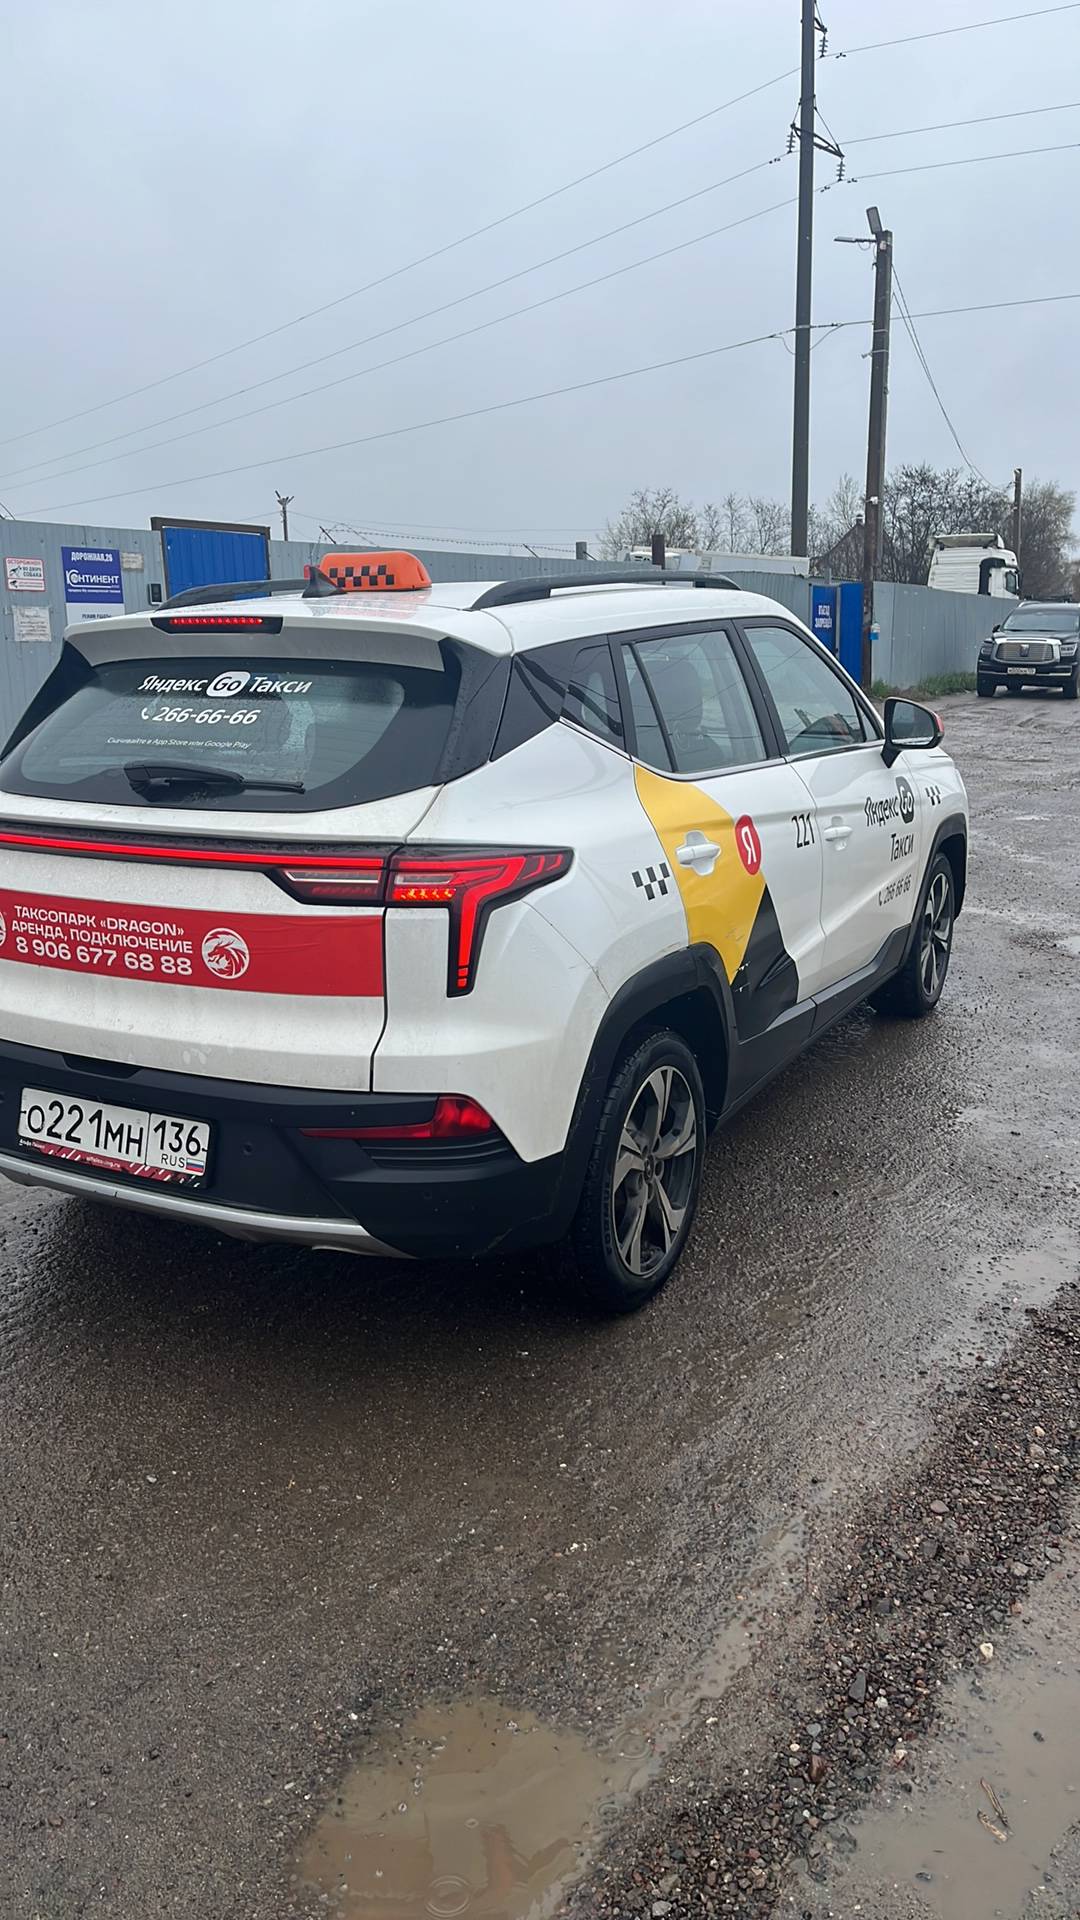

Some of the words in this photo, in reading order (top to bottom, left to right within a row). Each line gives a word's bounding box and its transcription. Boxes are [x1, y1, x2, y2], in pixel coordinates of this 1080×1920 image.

[138, 675, 208, 692] Яндекс
[213, 676, 242, 691] Go
[250, 676, 313, 693] Такси
[152, 707, 261, 724] 266-66-66
[152, 738, 168, 747] App
[168, 738, 188, 747] Store
[204, 740, 233, 749] Google
[232, 741, 252, 750] Play
[864, 796, 899, 827] Яндекс
[900, 785, 914, 814] Go
[741, 826, 757, 864] Я
[791, 811, 815, 848] 221
[890, 832, 914, 862] Такси
[14, 905, 96, 927] ТАКСОПАРК
[100, 917, 184, 936] «DRAGON»
[12, 920, 67, 942] АРЕНДА,
[70, 928, 193, 954] ПОДКЛЮЧЕНИЕ
[15, 936, 28, 953] 8
[32, 939, 72, 960] 906
[76, 946, 117, 967] 677
[124, 952, 154, 971] 68
[161, 956, 193, 975] 88
[153, 1119, 201, 1156] 136
[161, 1153, 186, 1168] RUS
